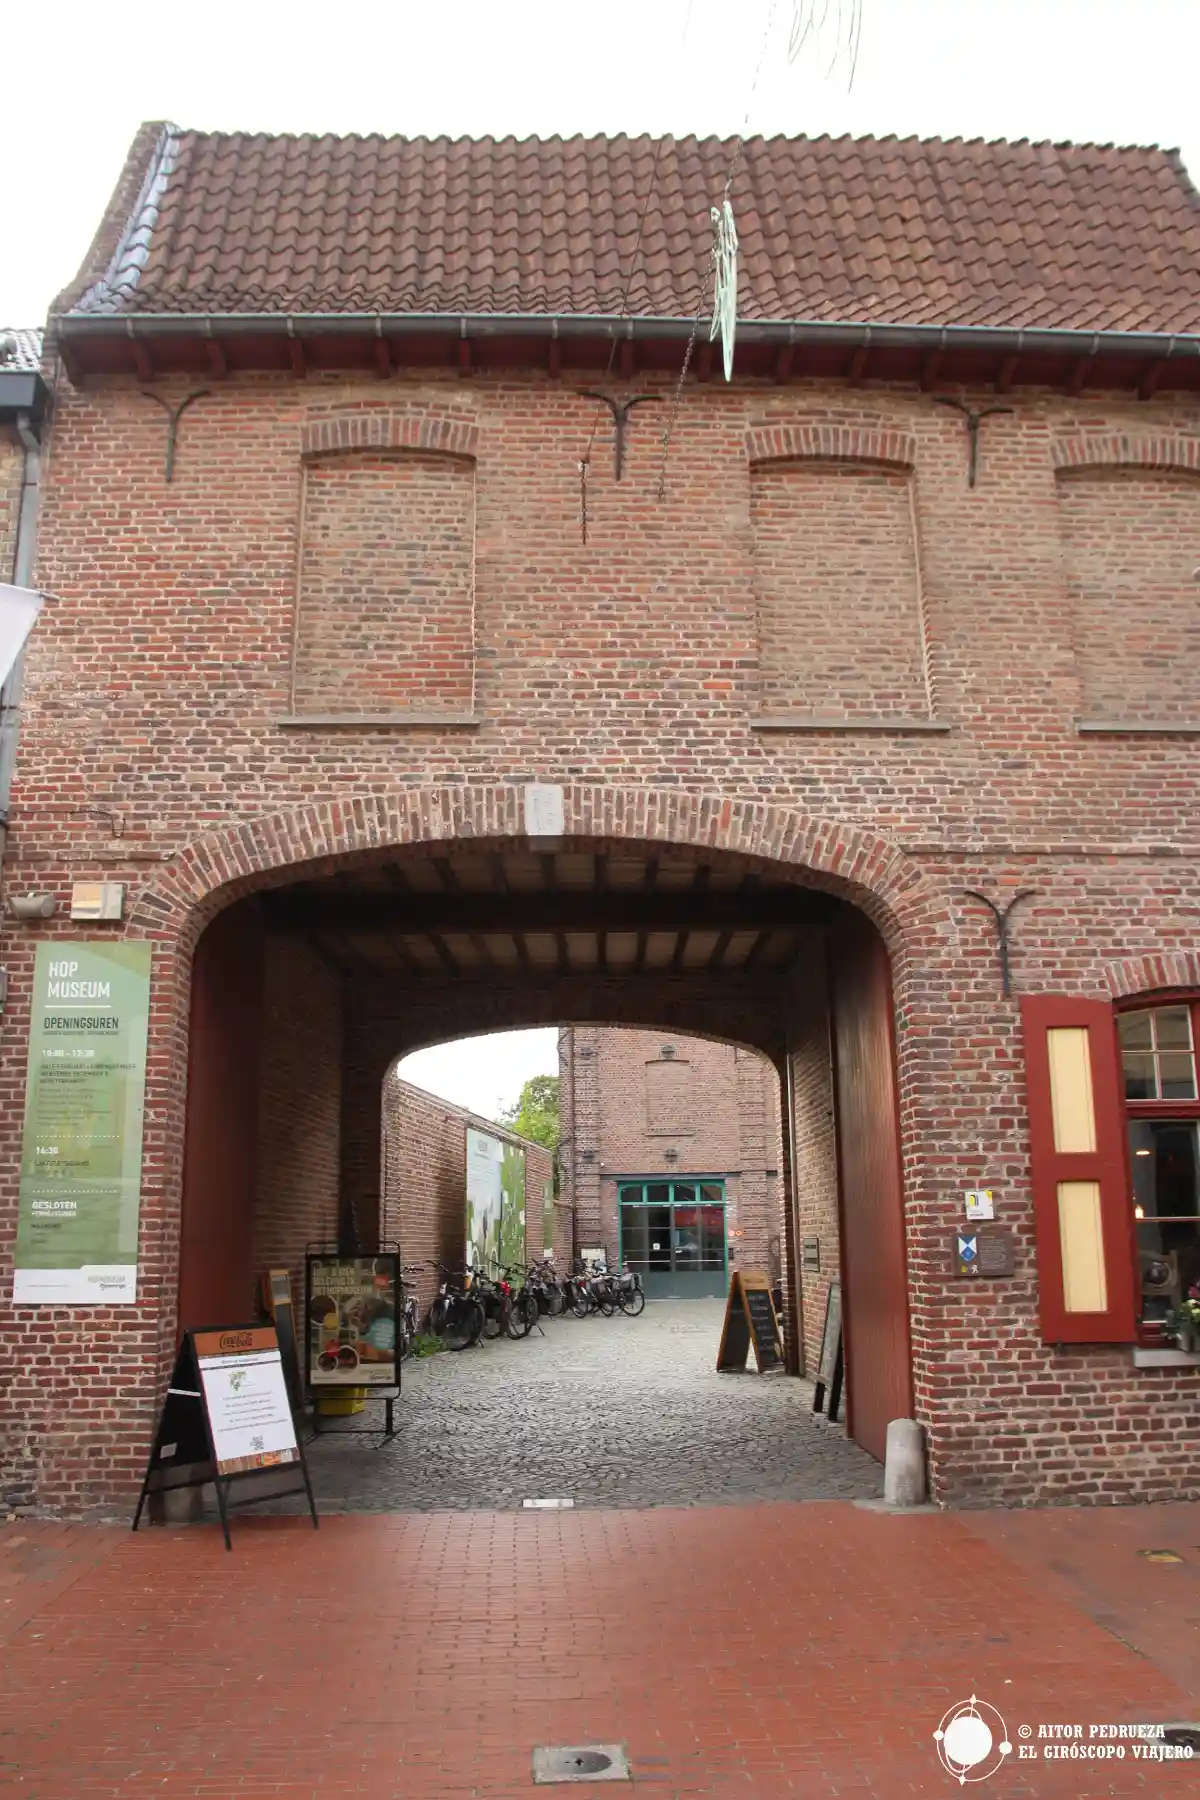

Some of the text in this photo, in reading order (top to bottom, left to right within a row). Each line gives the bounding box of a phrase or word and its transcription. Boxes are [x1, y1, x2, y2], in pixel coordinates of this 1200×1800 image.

[48, 961, 78, 978] HOP
[47, 981, 111, 998] MUSEUM
[44, 1017, 119, 1029] OPENINGSUREN
[31, 1201, 77, 1209] GESLOTEN
